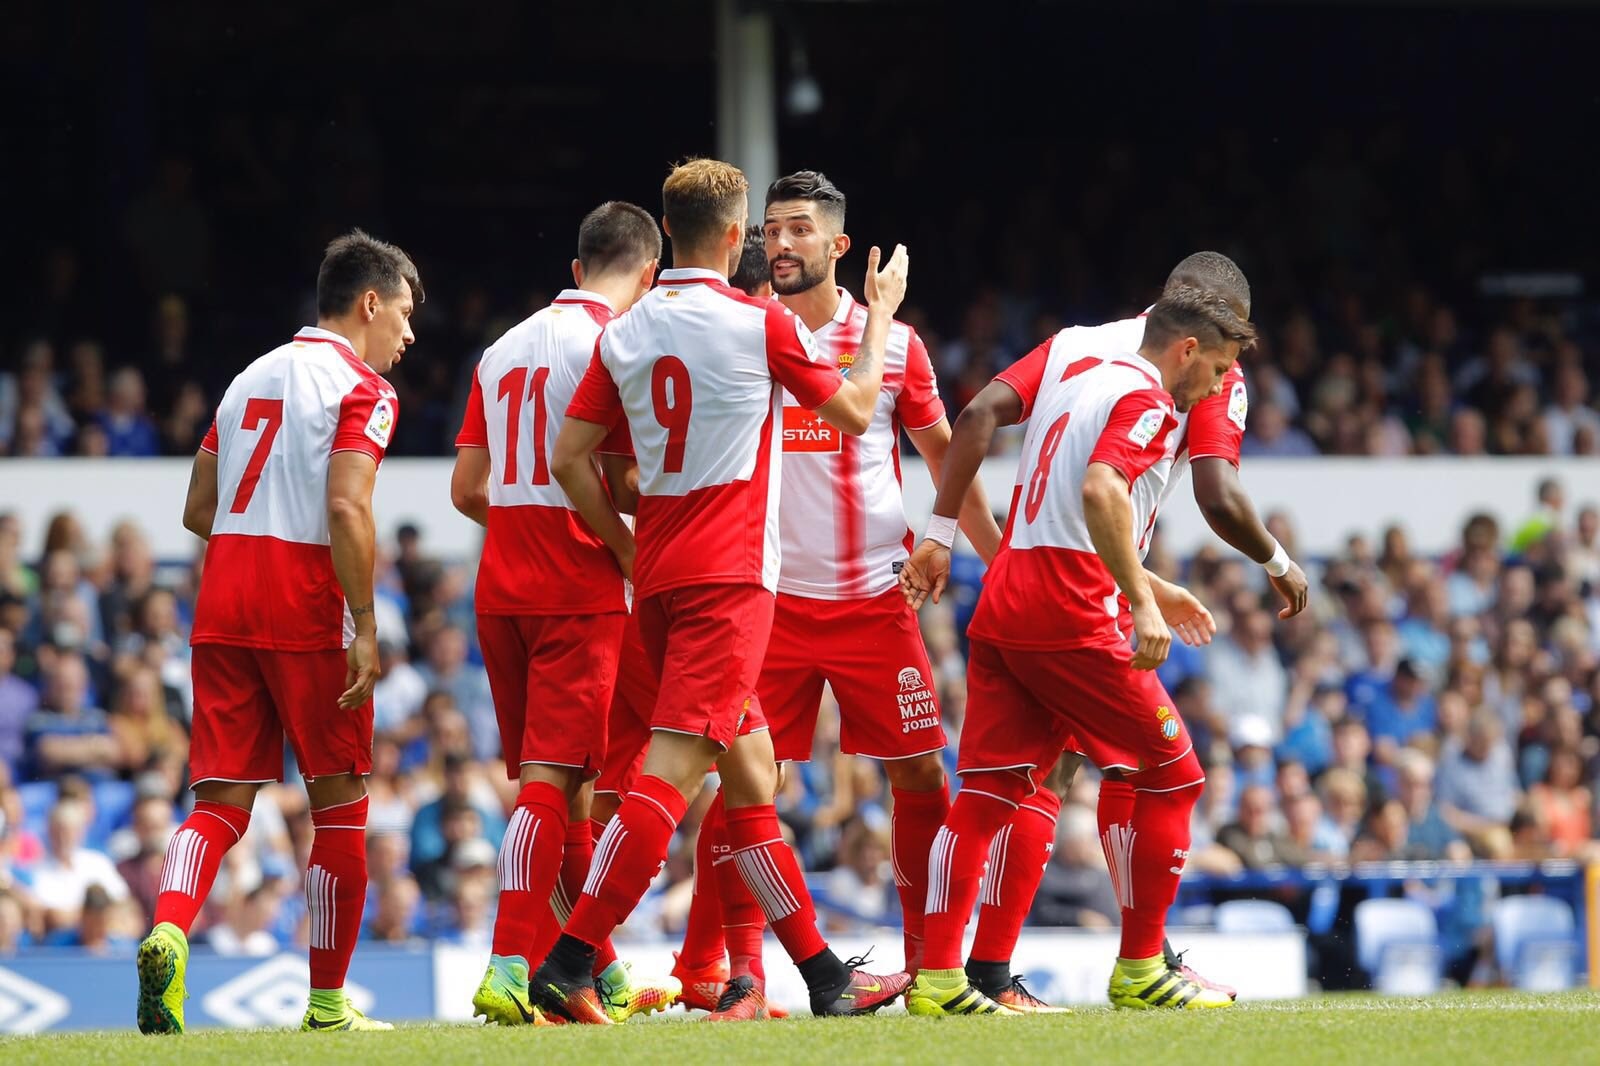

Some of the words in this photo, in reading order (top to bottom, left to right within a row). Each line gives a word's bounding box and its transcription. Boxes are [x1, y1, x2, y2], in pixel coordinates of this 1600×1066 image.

[229, 398, 284, 514] 7
[497, 366, 550, 486] 11
[651, 355, 693, 473] 9
[1024, 411, 1071, 525] 8
[899, 700, 936, 720] MAYA
